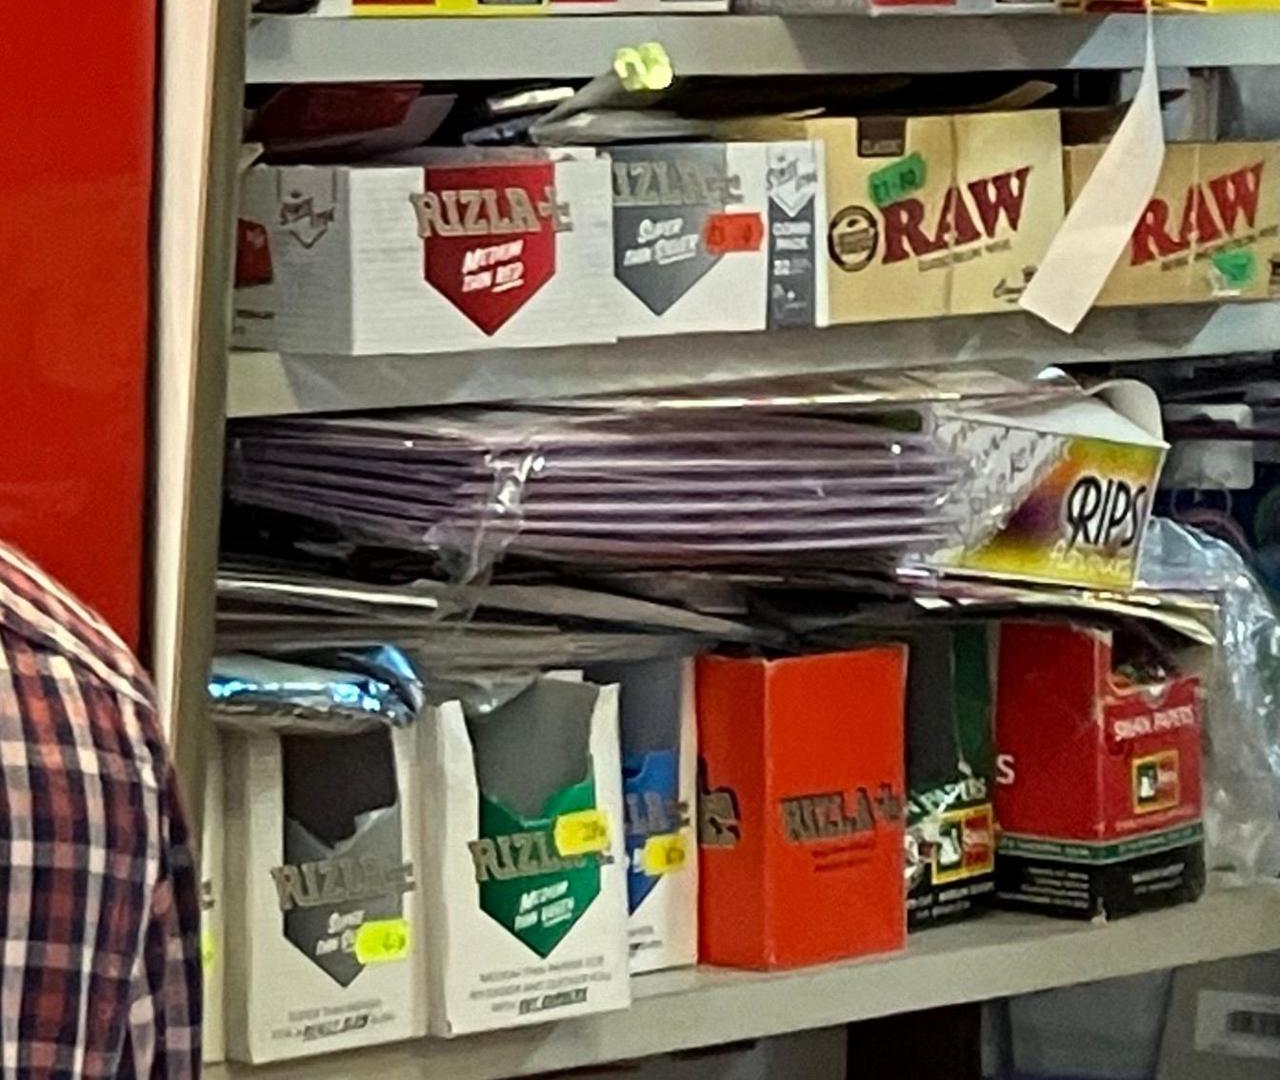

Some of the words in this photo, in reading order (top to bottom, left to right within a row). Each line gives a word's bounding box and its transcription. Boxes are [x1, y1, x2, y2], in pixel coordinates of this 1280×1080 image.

[880, 166, 1033, 265] RAW
[1130, 160, 1266, 267] RAW
[1067, 475, 1146, 552] RIPS
